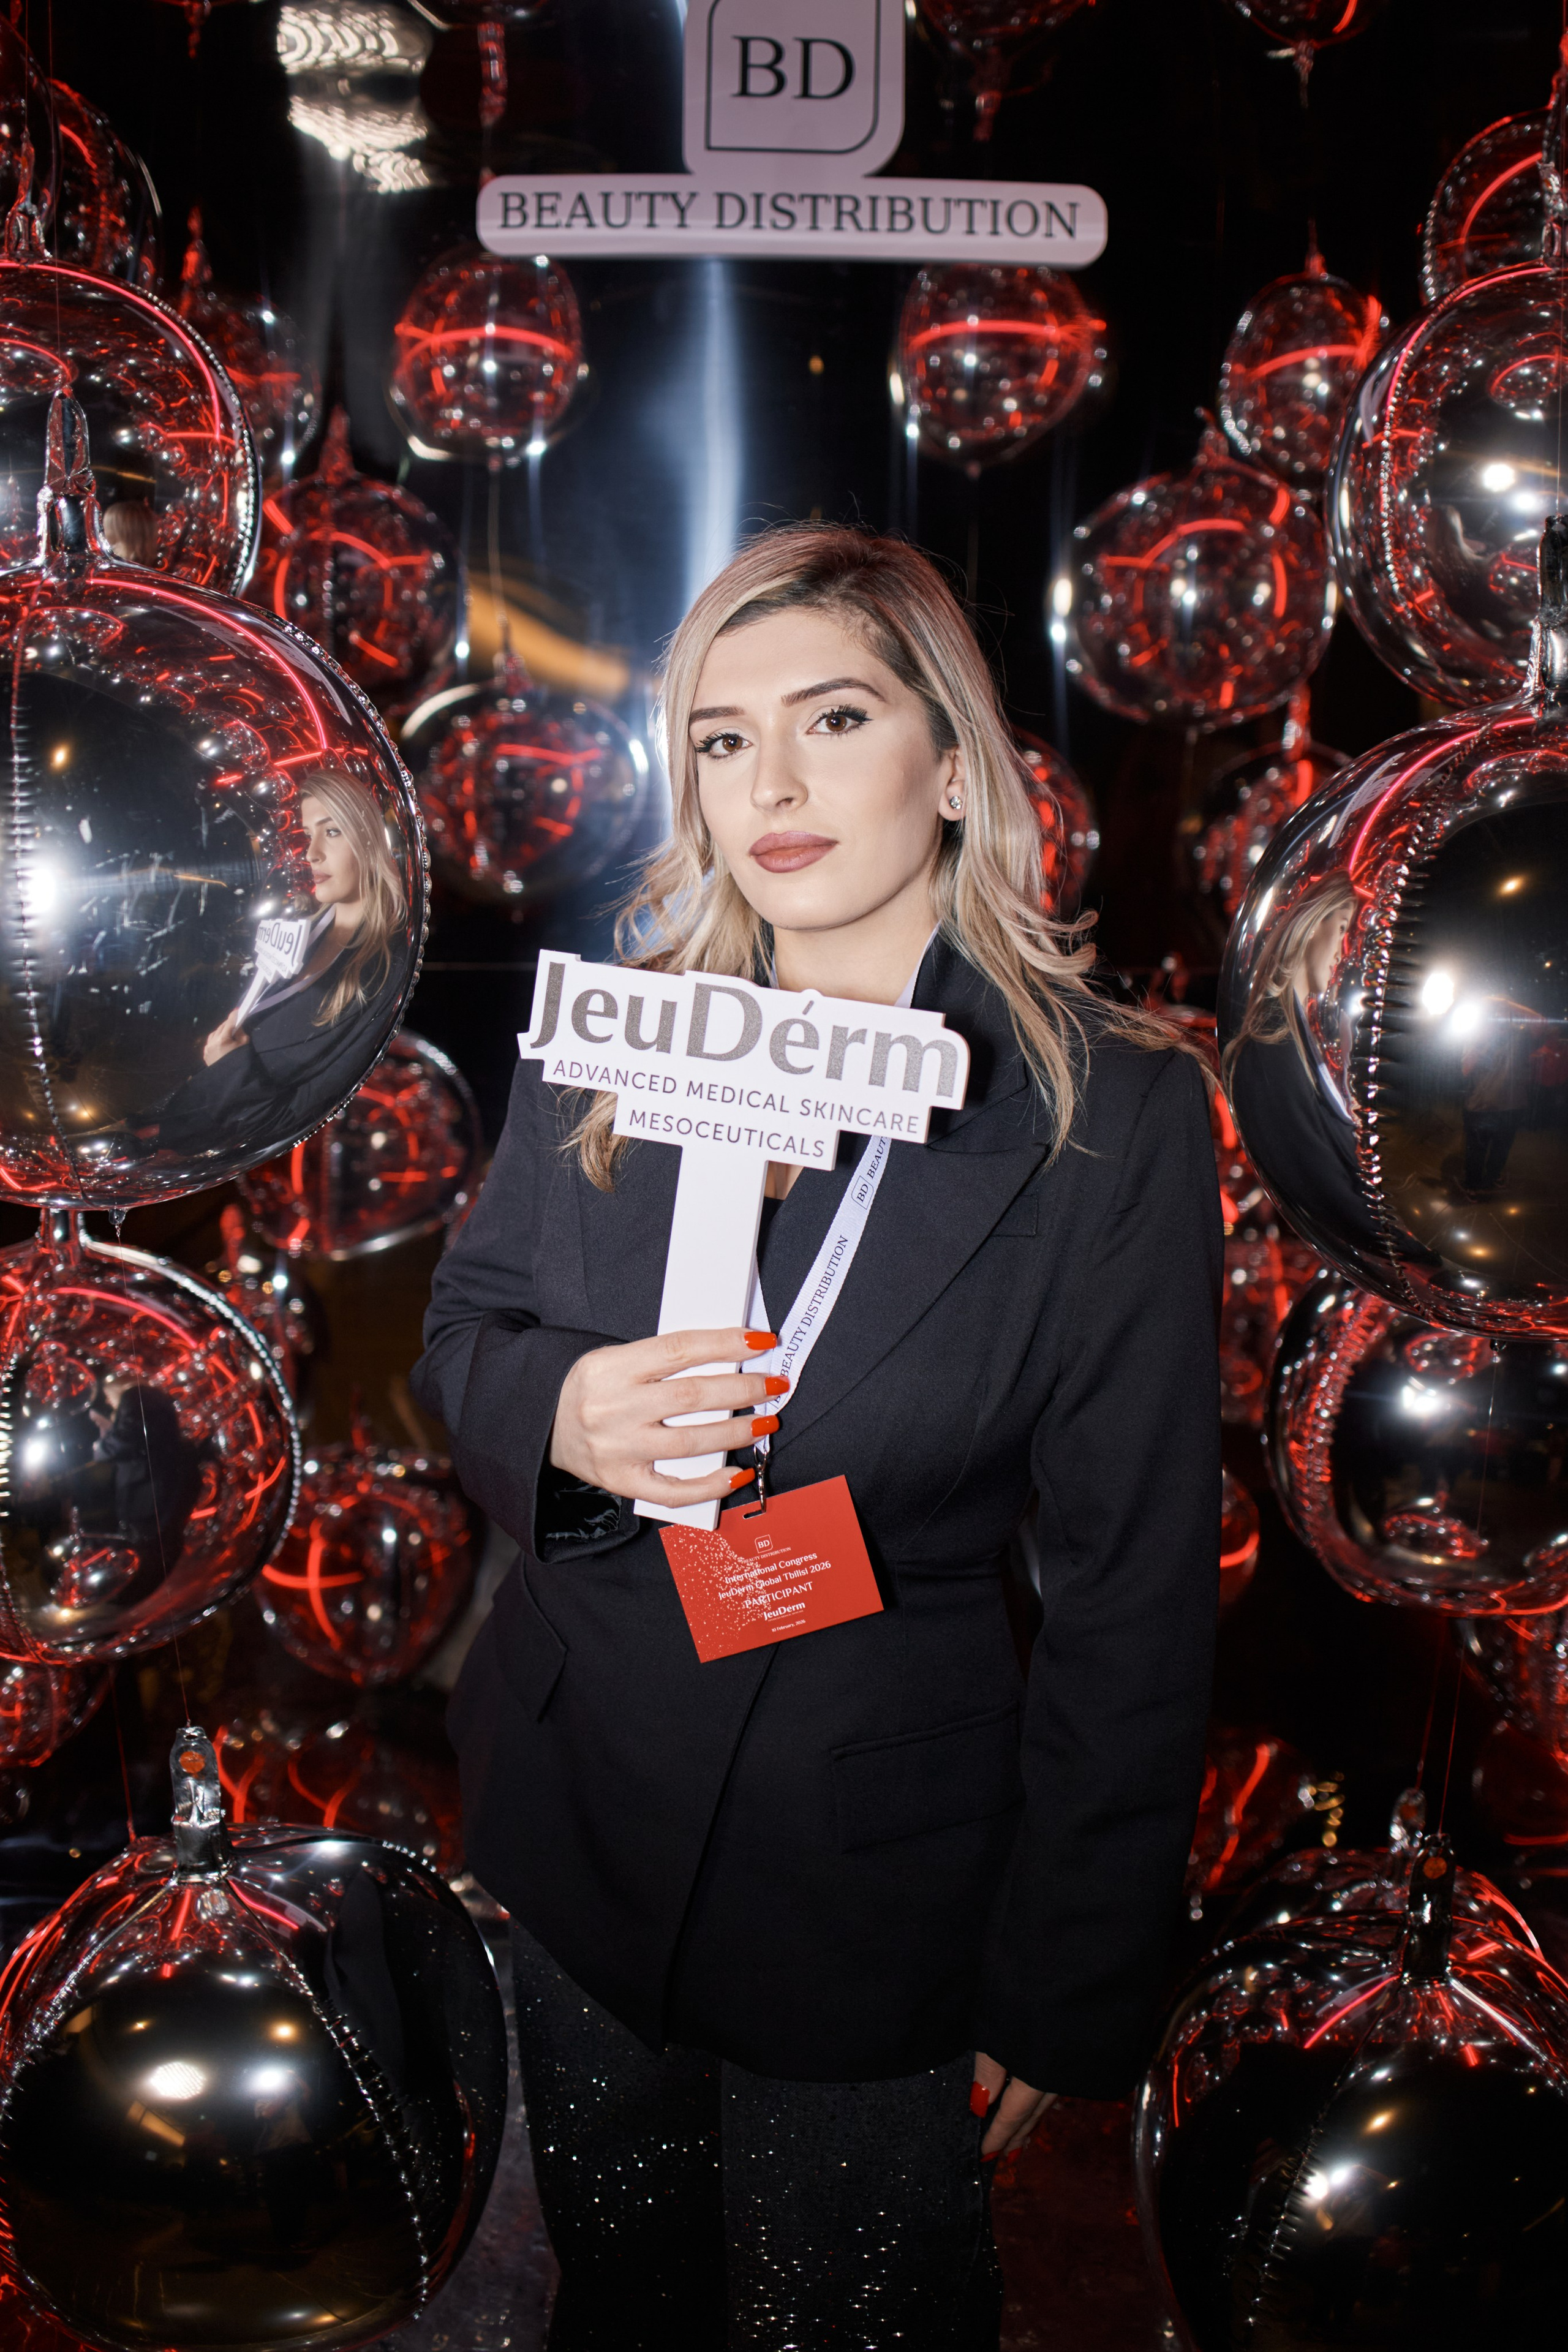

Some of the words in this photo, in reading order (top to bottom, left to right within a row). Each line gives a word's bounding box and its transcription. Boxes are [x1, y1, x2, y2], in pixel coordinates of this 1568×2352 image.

[731, 35, 856, 100] BD
[499, 190, 699, 229] BEAUTY
[714, 192, 1080, 239] DISTRIBUTION
[530, 961, 959, 1098] JeuDérm
[554, 1059, 677, 1094] ADVANCED
[686, 1082, 790, 1114] MEDICAL
[799, 1099, 919, 1134] SKINCARE
[628, 1109, 824, 1158] MESOCEUTICALS
[856, 1184, 869, 1203] BD
[867, 1136, 888, 1179] BEAUT
[780, 1327, 807, 1378] BEAUTY
[801, 1234, 849, 1328] DISTRIBUTION
[758, 1539, 771, 1549] BD
[761, 1547, 791, 1559] DISTRIBUTION
[725, 1563, 777, 1585] International
[778, 1553, 818, 1569] Congress
[755, 1575, 782, 1589] Global
[783, 1568, 809, 1581] Tbilisi
[809, 1560, 831, 1574] 2026
[744, 1581, 813, 1609] PARTICIPANT
[763, 1602, 806, 1621] JeuDérm
